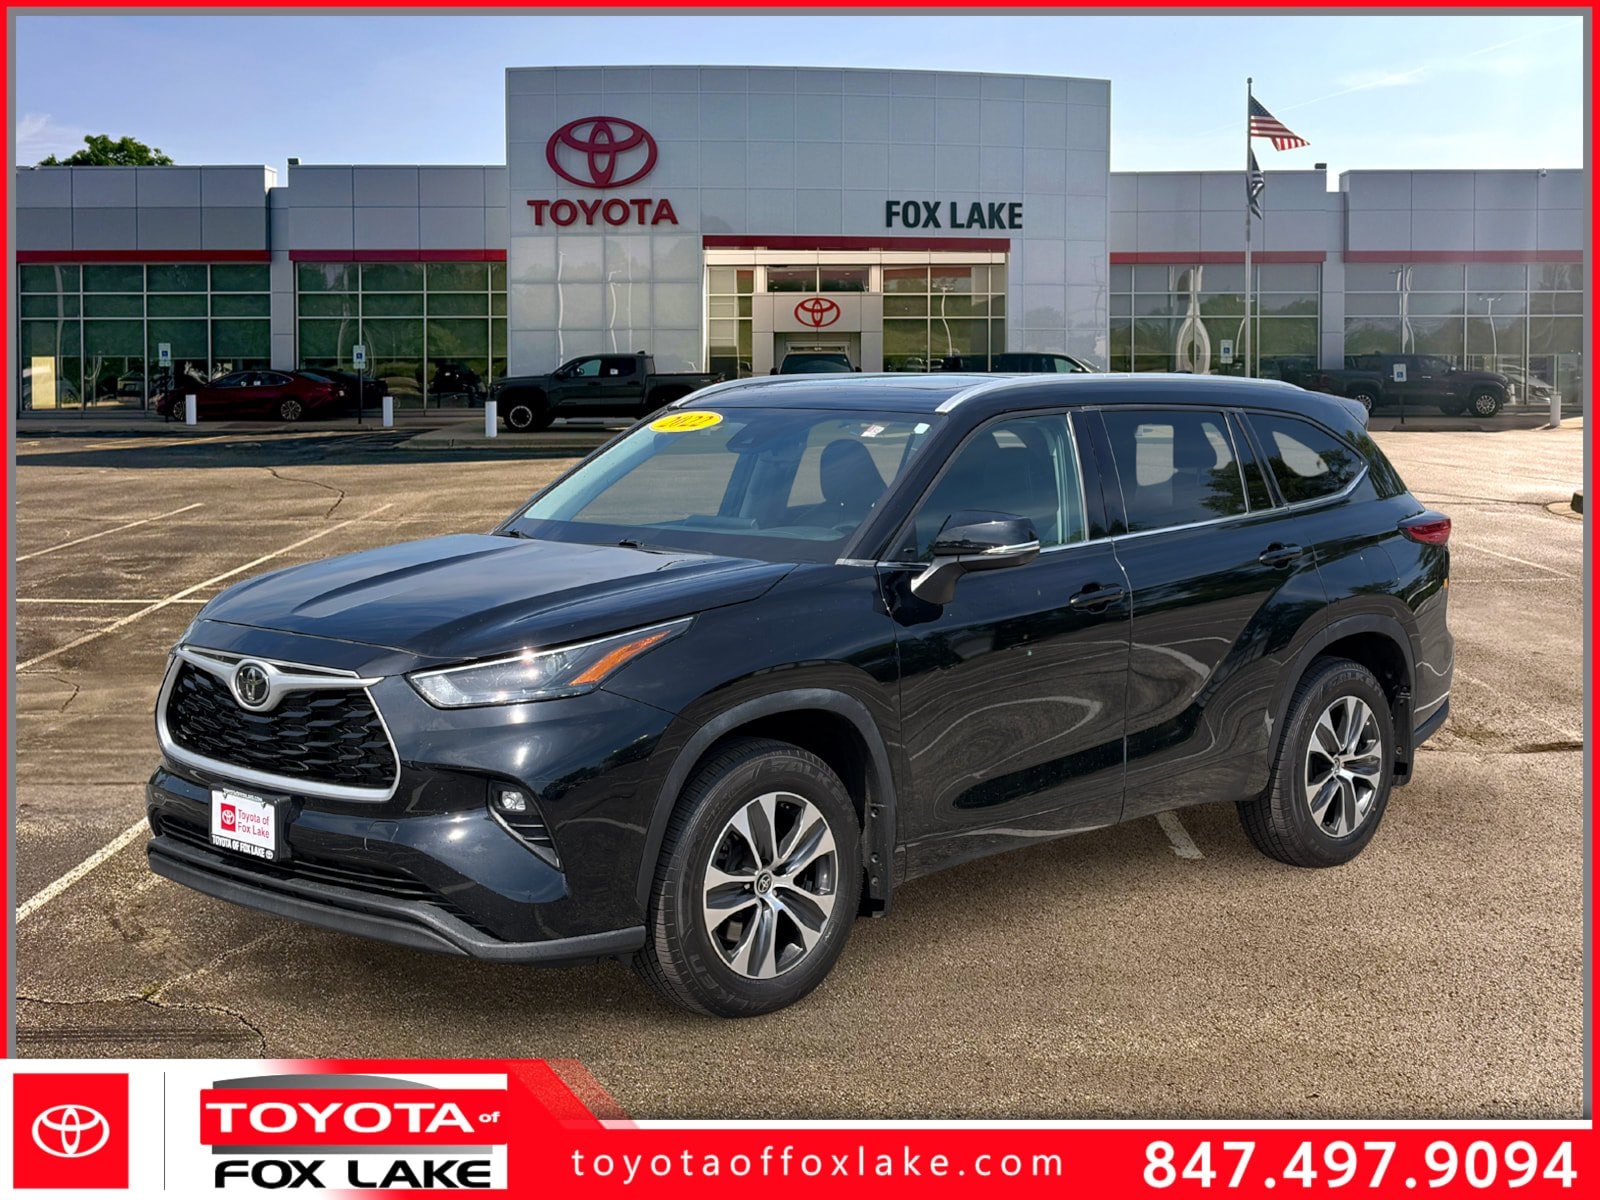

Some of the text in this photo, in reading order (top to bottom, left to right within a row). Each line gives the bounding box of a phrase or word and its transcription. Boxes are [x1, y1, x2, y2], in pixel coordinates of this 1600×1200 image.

[526, 198, 679, 227] TOYOTA
[885, 200, 1023, 230] FOX LAKE
[237, 808, 270, 826] Toyota of
[237, 821, 270, 839] Fox Lake
[211, 834, 265, 858] TOYOTA OF FOX LAKE
